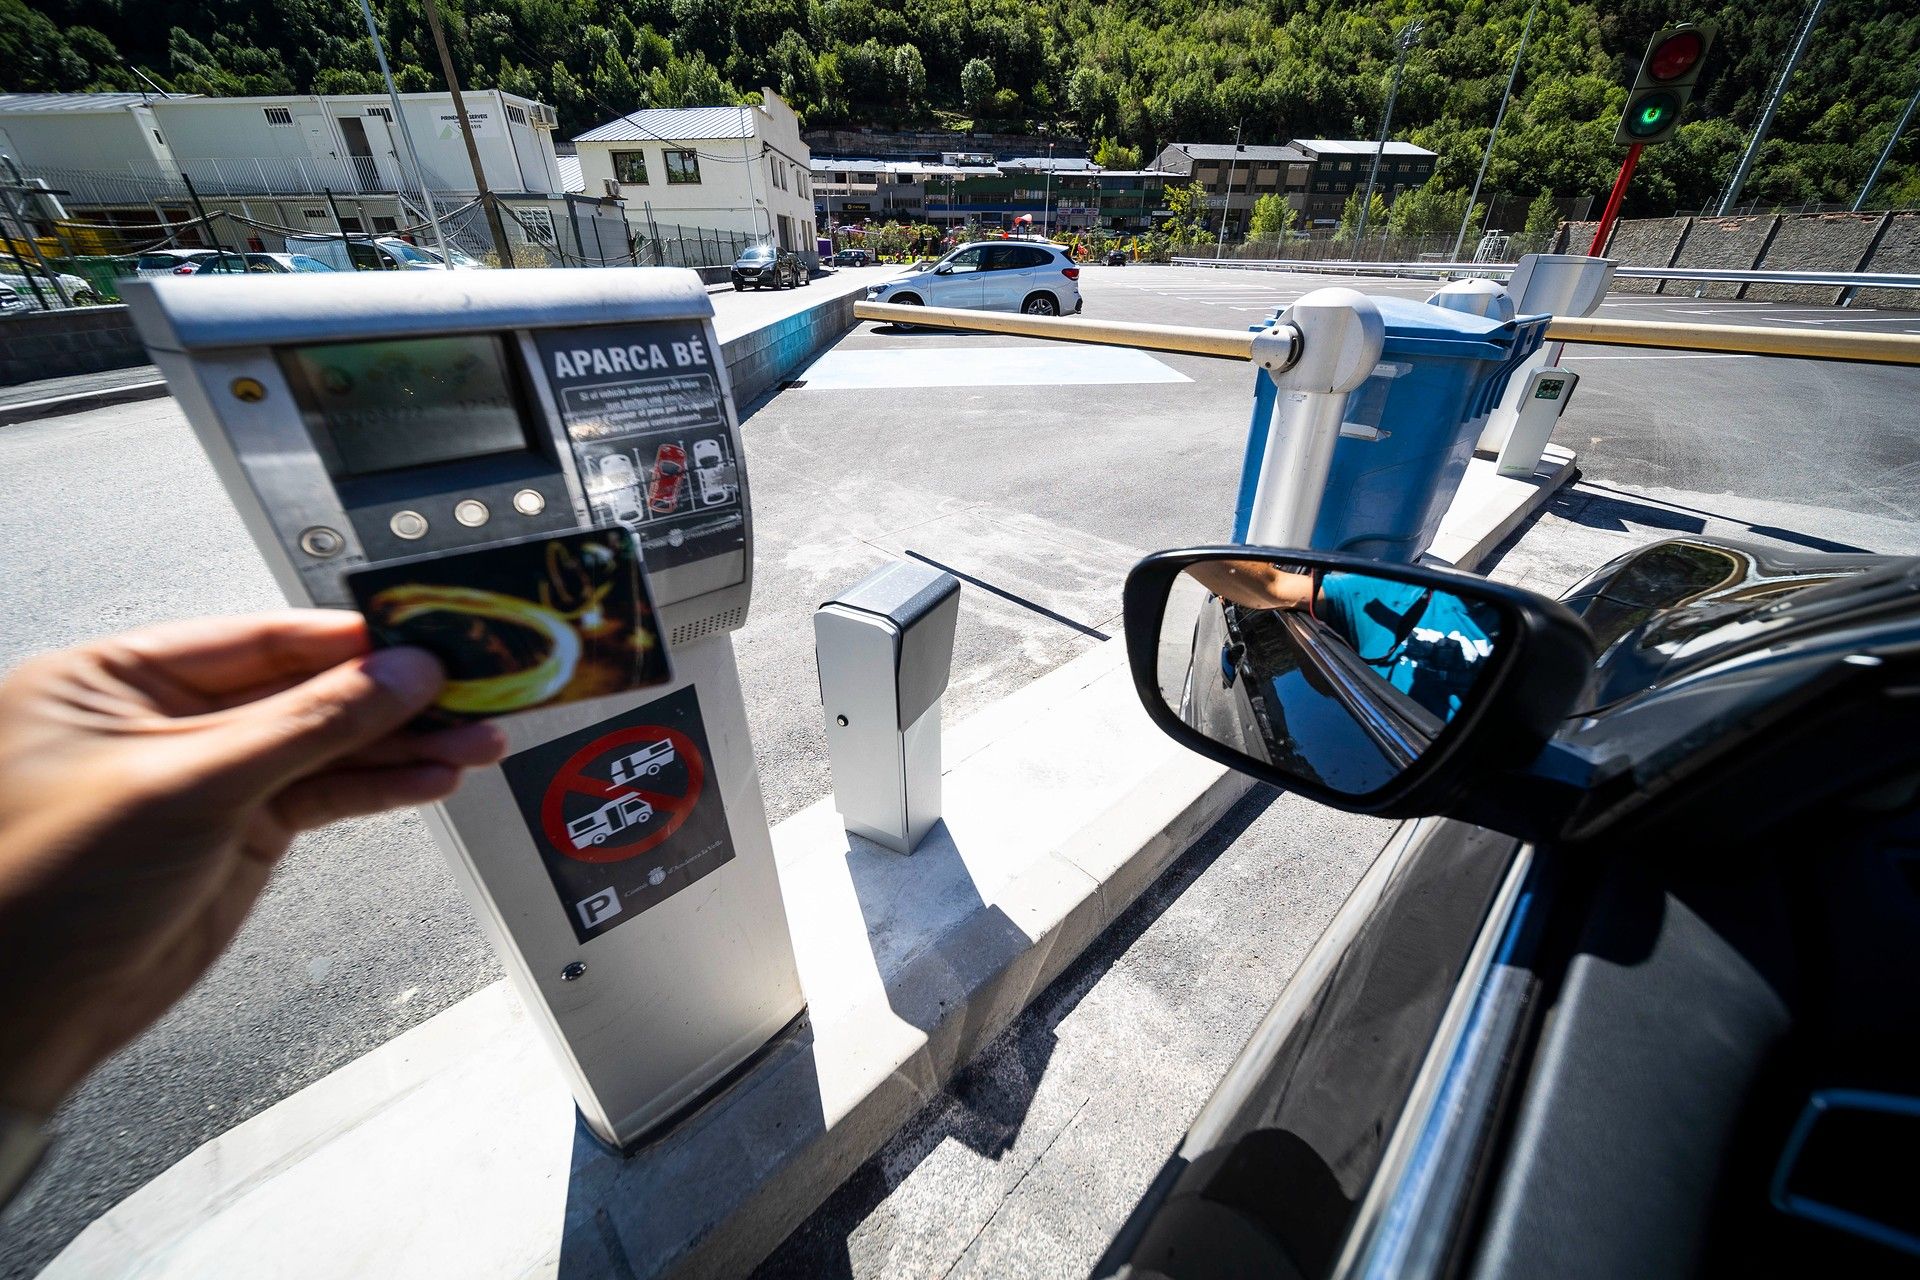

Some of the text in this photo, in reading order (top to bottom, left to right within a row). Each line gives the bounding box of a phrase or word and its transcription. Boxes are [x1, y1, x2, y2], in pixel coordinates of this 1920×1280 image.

[555, 336, 707, 378] APARCA BÉ
[584, 894, 611, 924] P
